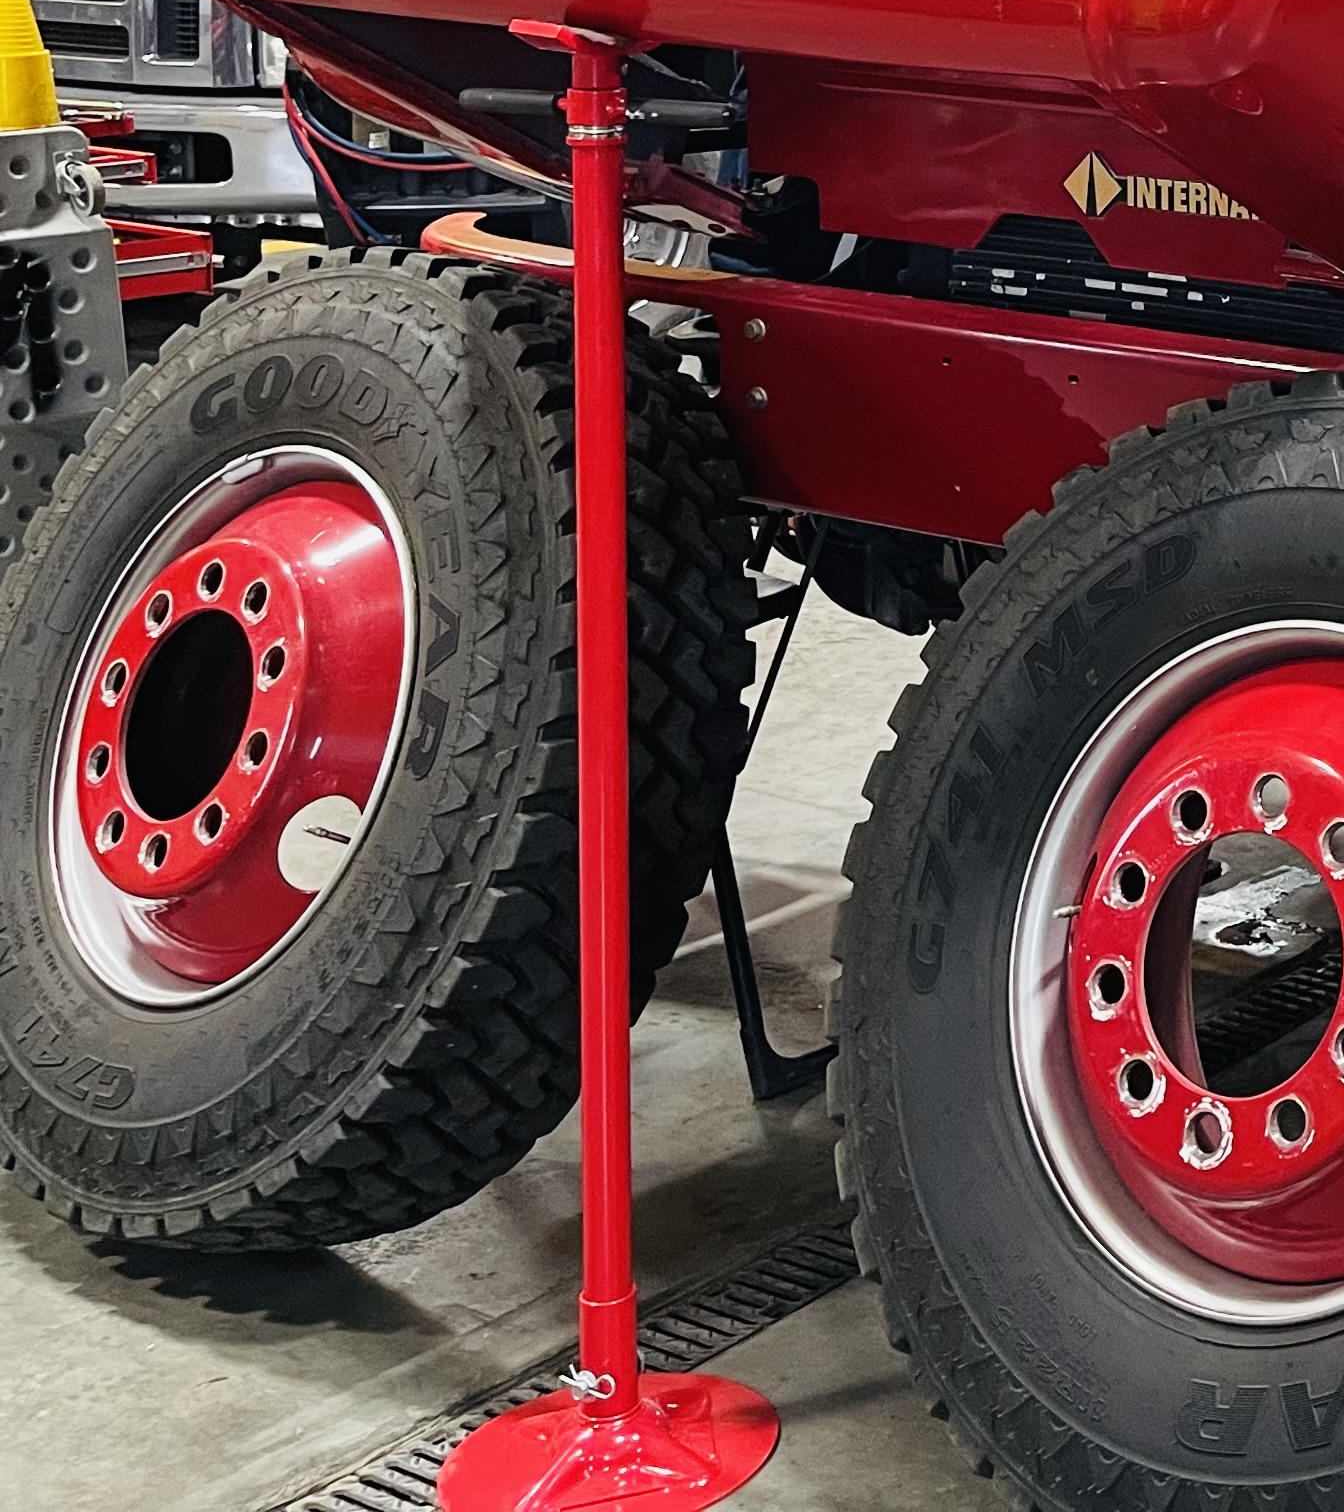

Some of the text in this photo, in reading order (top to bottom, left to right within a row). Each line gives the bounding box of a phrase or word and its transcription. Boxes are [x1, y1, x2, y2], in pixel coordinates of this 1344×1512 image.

[1127, 175, 1260, 221] INTERNA
[1021, 532, 1198, 698] MSD
[14, 1002, 137, 1111] G741
